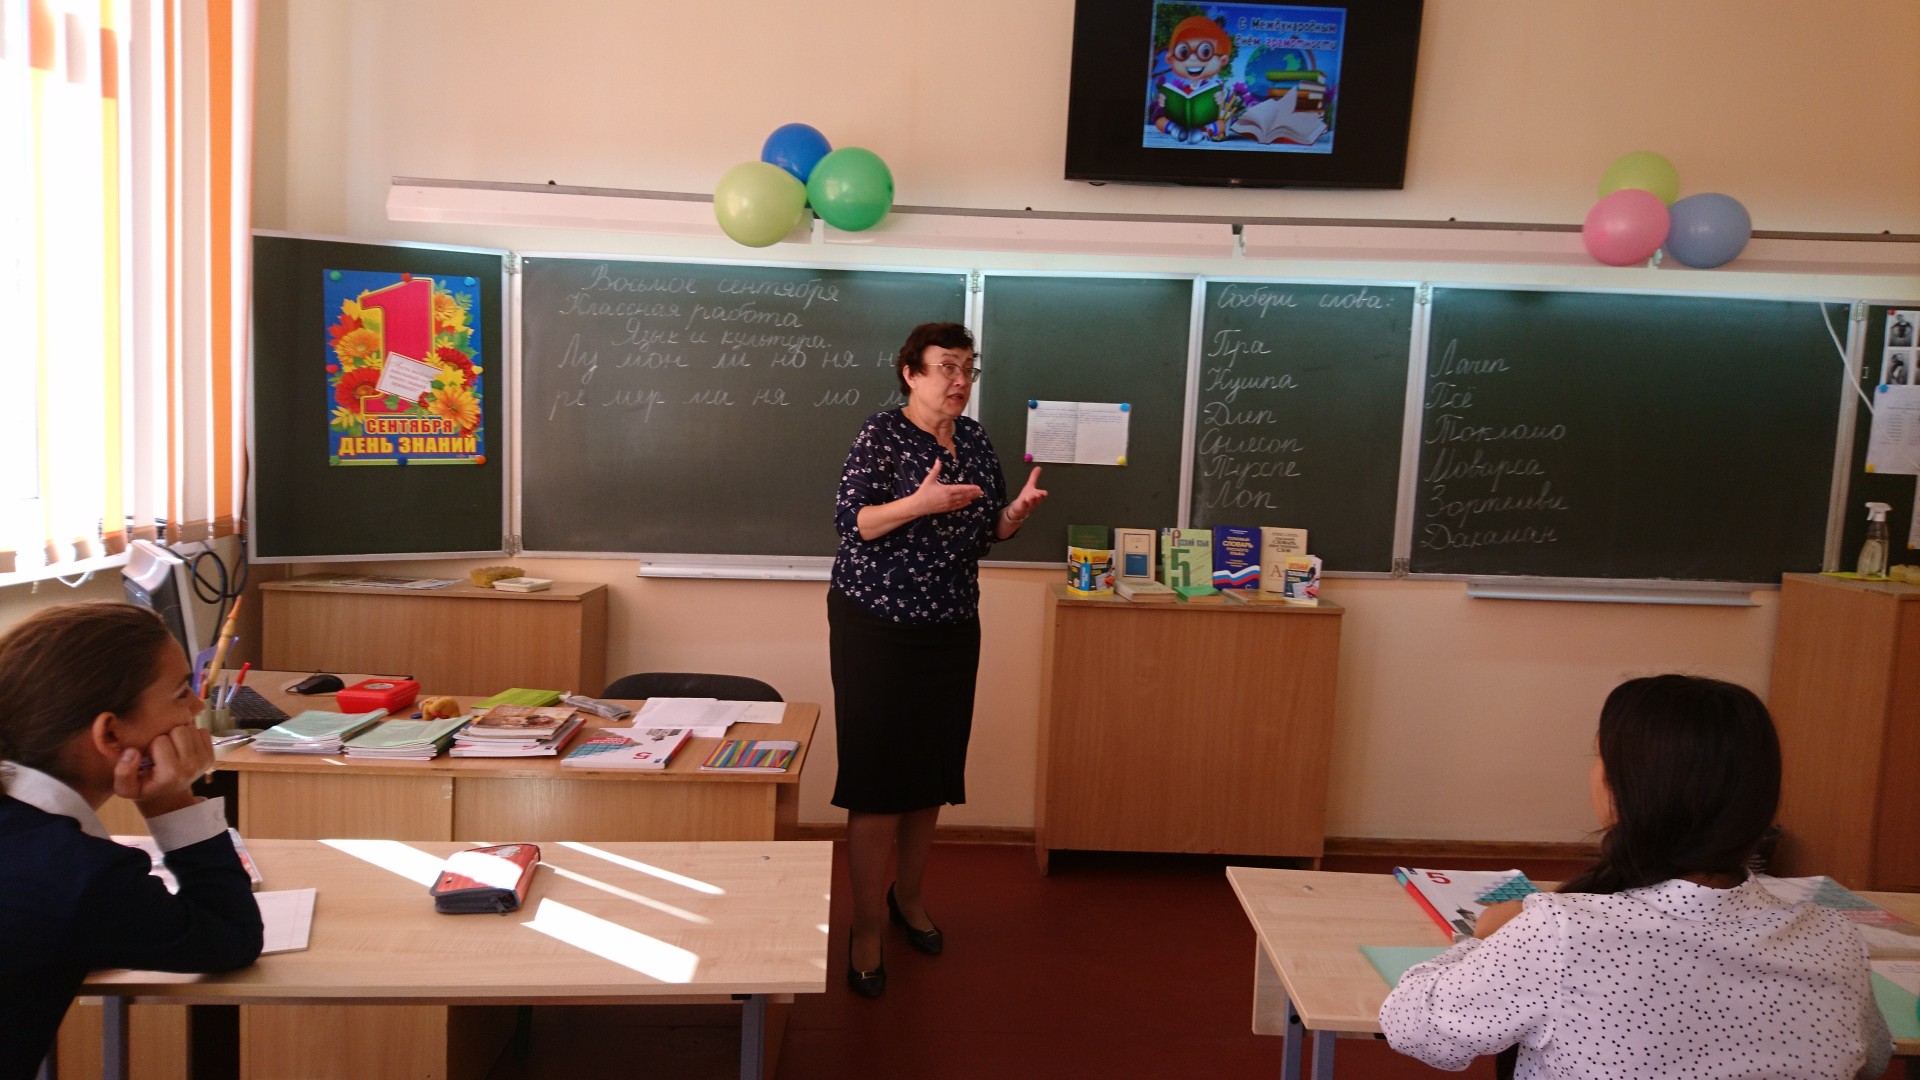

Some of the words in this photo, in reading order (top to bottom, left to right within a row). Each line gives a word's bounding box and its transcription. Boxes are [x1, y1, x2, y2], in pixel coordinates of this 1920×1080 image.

[1251, 17, 1337, 34] Международным
[581, 264, 697, 294] Восьмое
[717, 278, 840, 310] сентября
[1217, 284, 1298, 318] Собери
[559, 294, 681, 317] Классная
[685, 302, 804, 330] работа
[611, 317, 680, 350] Язык
[690, 333, 709, 344] и
[1208, 329, 1272, 368] Пра
[558, 333, 598, 384] Лу
[616, 352, 689, 369] мон
[712, 352, 751, 369] ли
[771, 350, 808, 368] но
[822, 350, 861, 368] ня
[549, 389, 586, 421] ре
[602, 389, 665, 424] мер
[752, 388, 790, 406] ня
[814, 388, 861, 407] мо
[365, 418, 455, 434] СЕНТЯБРЯ
[338, 436, 395, 456] ДЕНЬ
[398, 436, 477, 454] ЗНАНИЙ
[1206, 480, 1278, 508] Лоп
[1171, 548, 1191, 588] 5
[1425, 871, 1452, 885] 5
